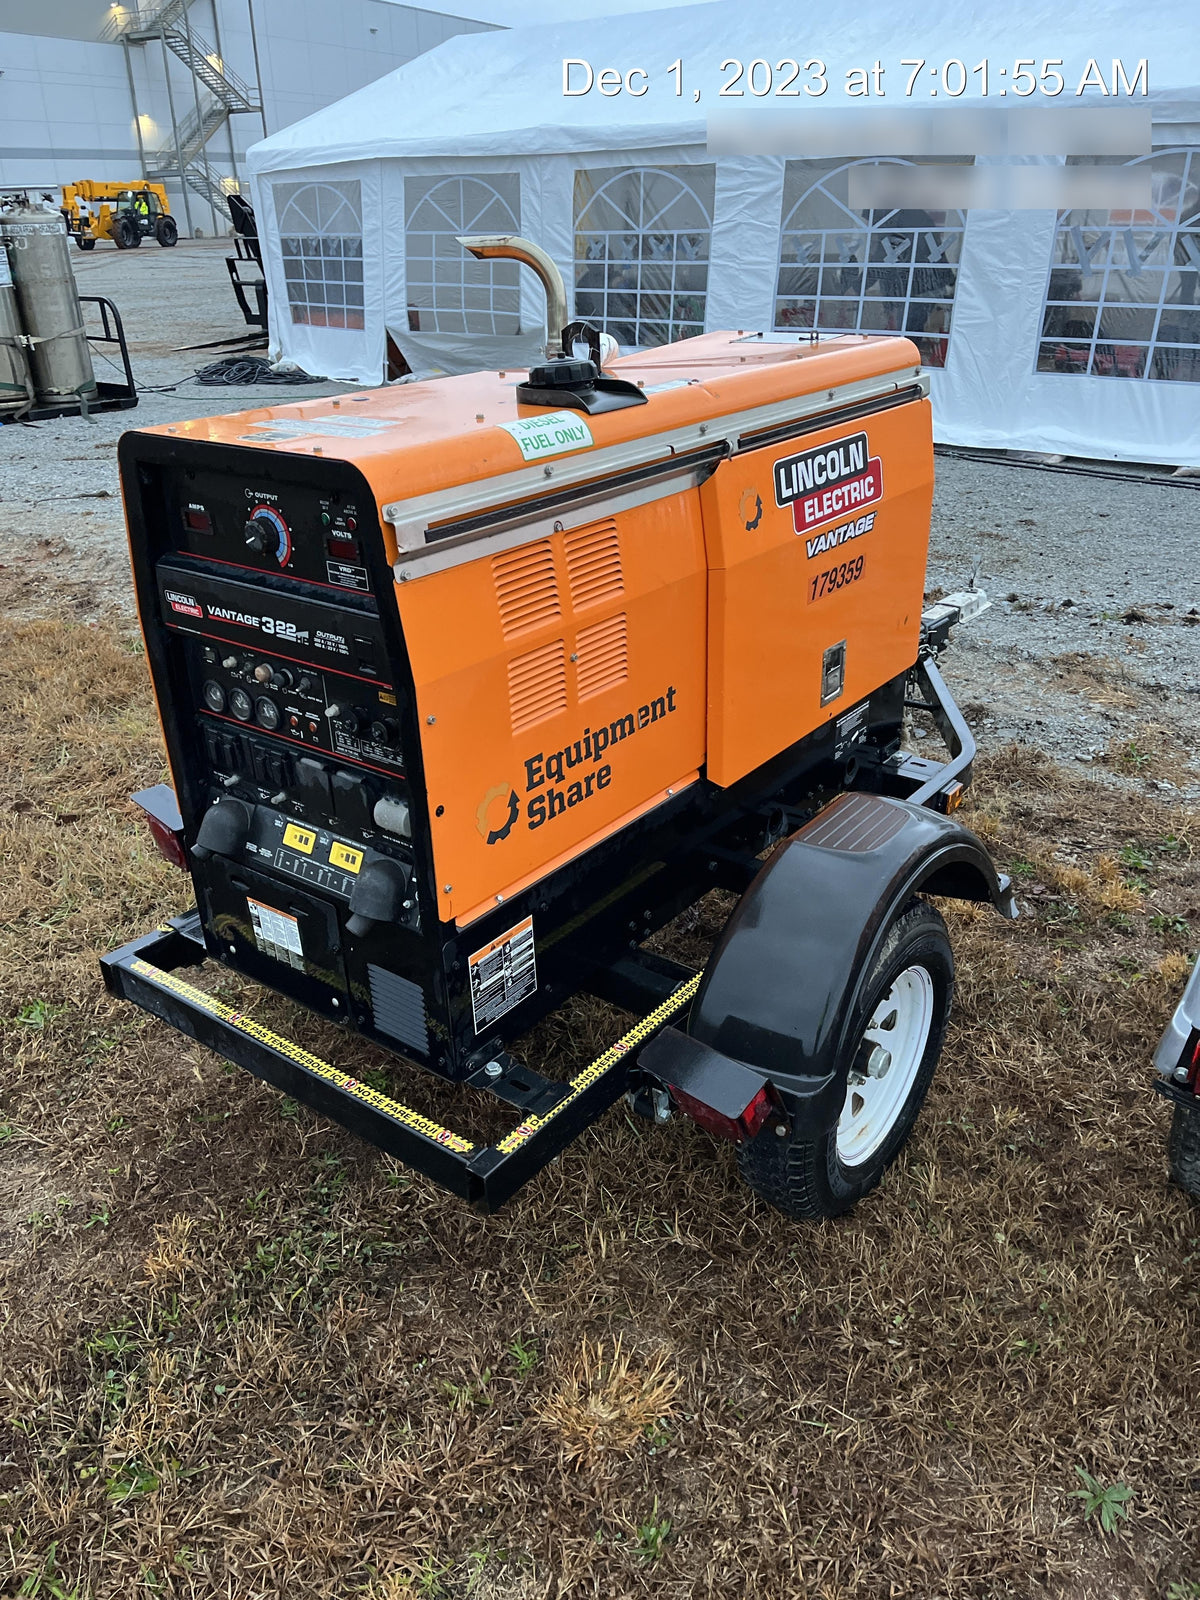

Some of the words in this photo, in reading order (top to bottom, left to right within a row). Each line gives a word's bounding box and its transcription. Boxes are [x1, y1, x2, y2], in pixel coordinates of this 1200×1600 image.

[517, 414, 565, 430] DIESEL
[521, 433, 555, 452] FUEL
[555, 425, 586, 444] ONLY
[779, 440, 864, 499] LINCOLN
[188, 503, 205, 511] AMPS
[254, 491, 279, 501] OUTPUT
[804, 475, 875, 524] ELECTRIC
[331, 529, 352, 539] VOLTS
[805, 512, 876, 559] VANTAGE
[811, 555, 864, 601] 179359
[167, 592, 195, 607] LINCOLN
[175, 603, 200, 616] ELECTRIC
[207, 604, 259, 627] VANTAGE
[261, 616, 297, 637] 322
[524, 686, 676, 792] Equipment
[527, 764, 611, 831] Share
[575, 1071, 595, 1088] AND
[595, 1051, 618, 1072] HERE
[626, 1032, 640, 1044] NE
[638, 1020, 655, 1036] PAS
[652, 999, 678, 1023] TENEZ
[675, 979, 700, 1001] DEBO
[155, 973, 168, 982] DO
[168, 979, 185, 990] NOT
[182, 988, 209, 1004] STAND
[209, 1003, 231, 1017] HERE
[238, 1018, 251, 1029] NE
[250, 1026, 269, 1038] PAS
[268, 1035, 295, 1054] TENEZ
[293, 1051, 331, 1075] DEBOUT
[330, 1073, 345, 1084] ICI
[354, 1086, 371, 1097] NO
[370, 1094, 386, 1106] SE
[384, 1102, 412, 1120] PARE
[410, 1117, 439, 1135] AQUI
